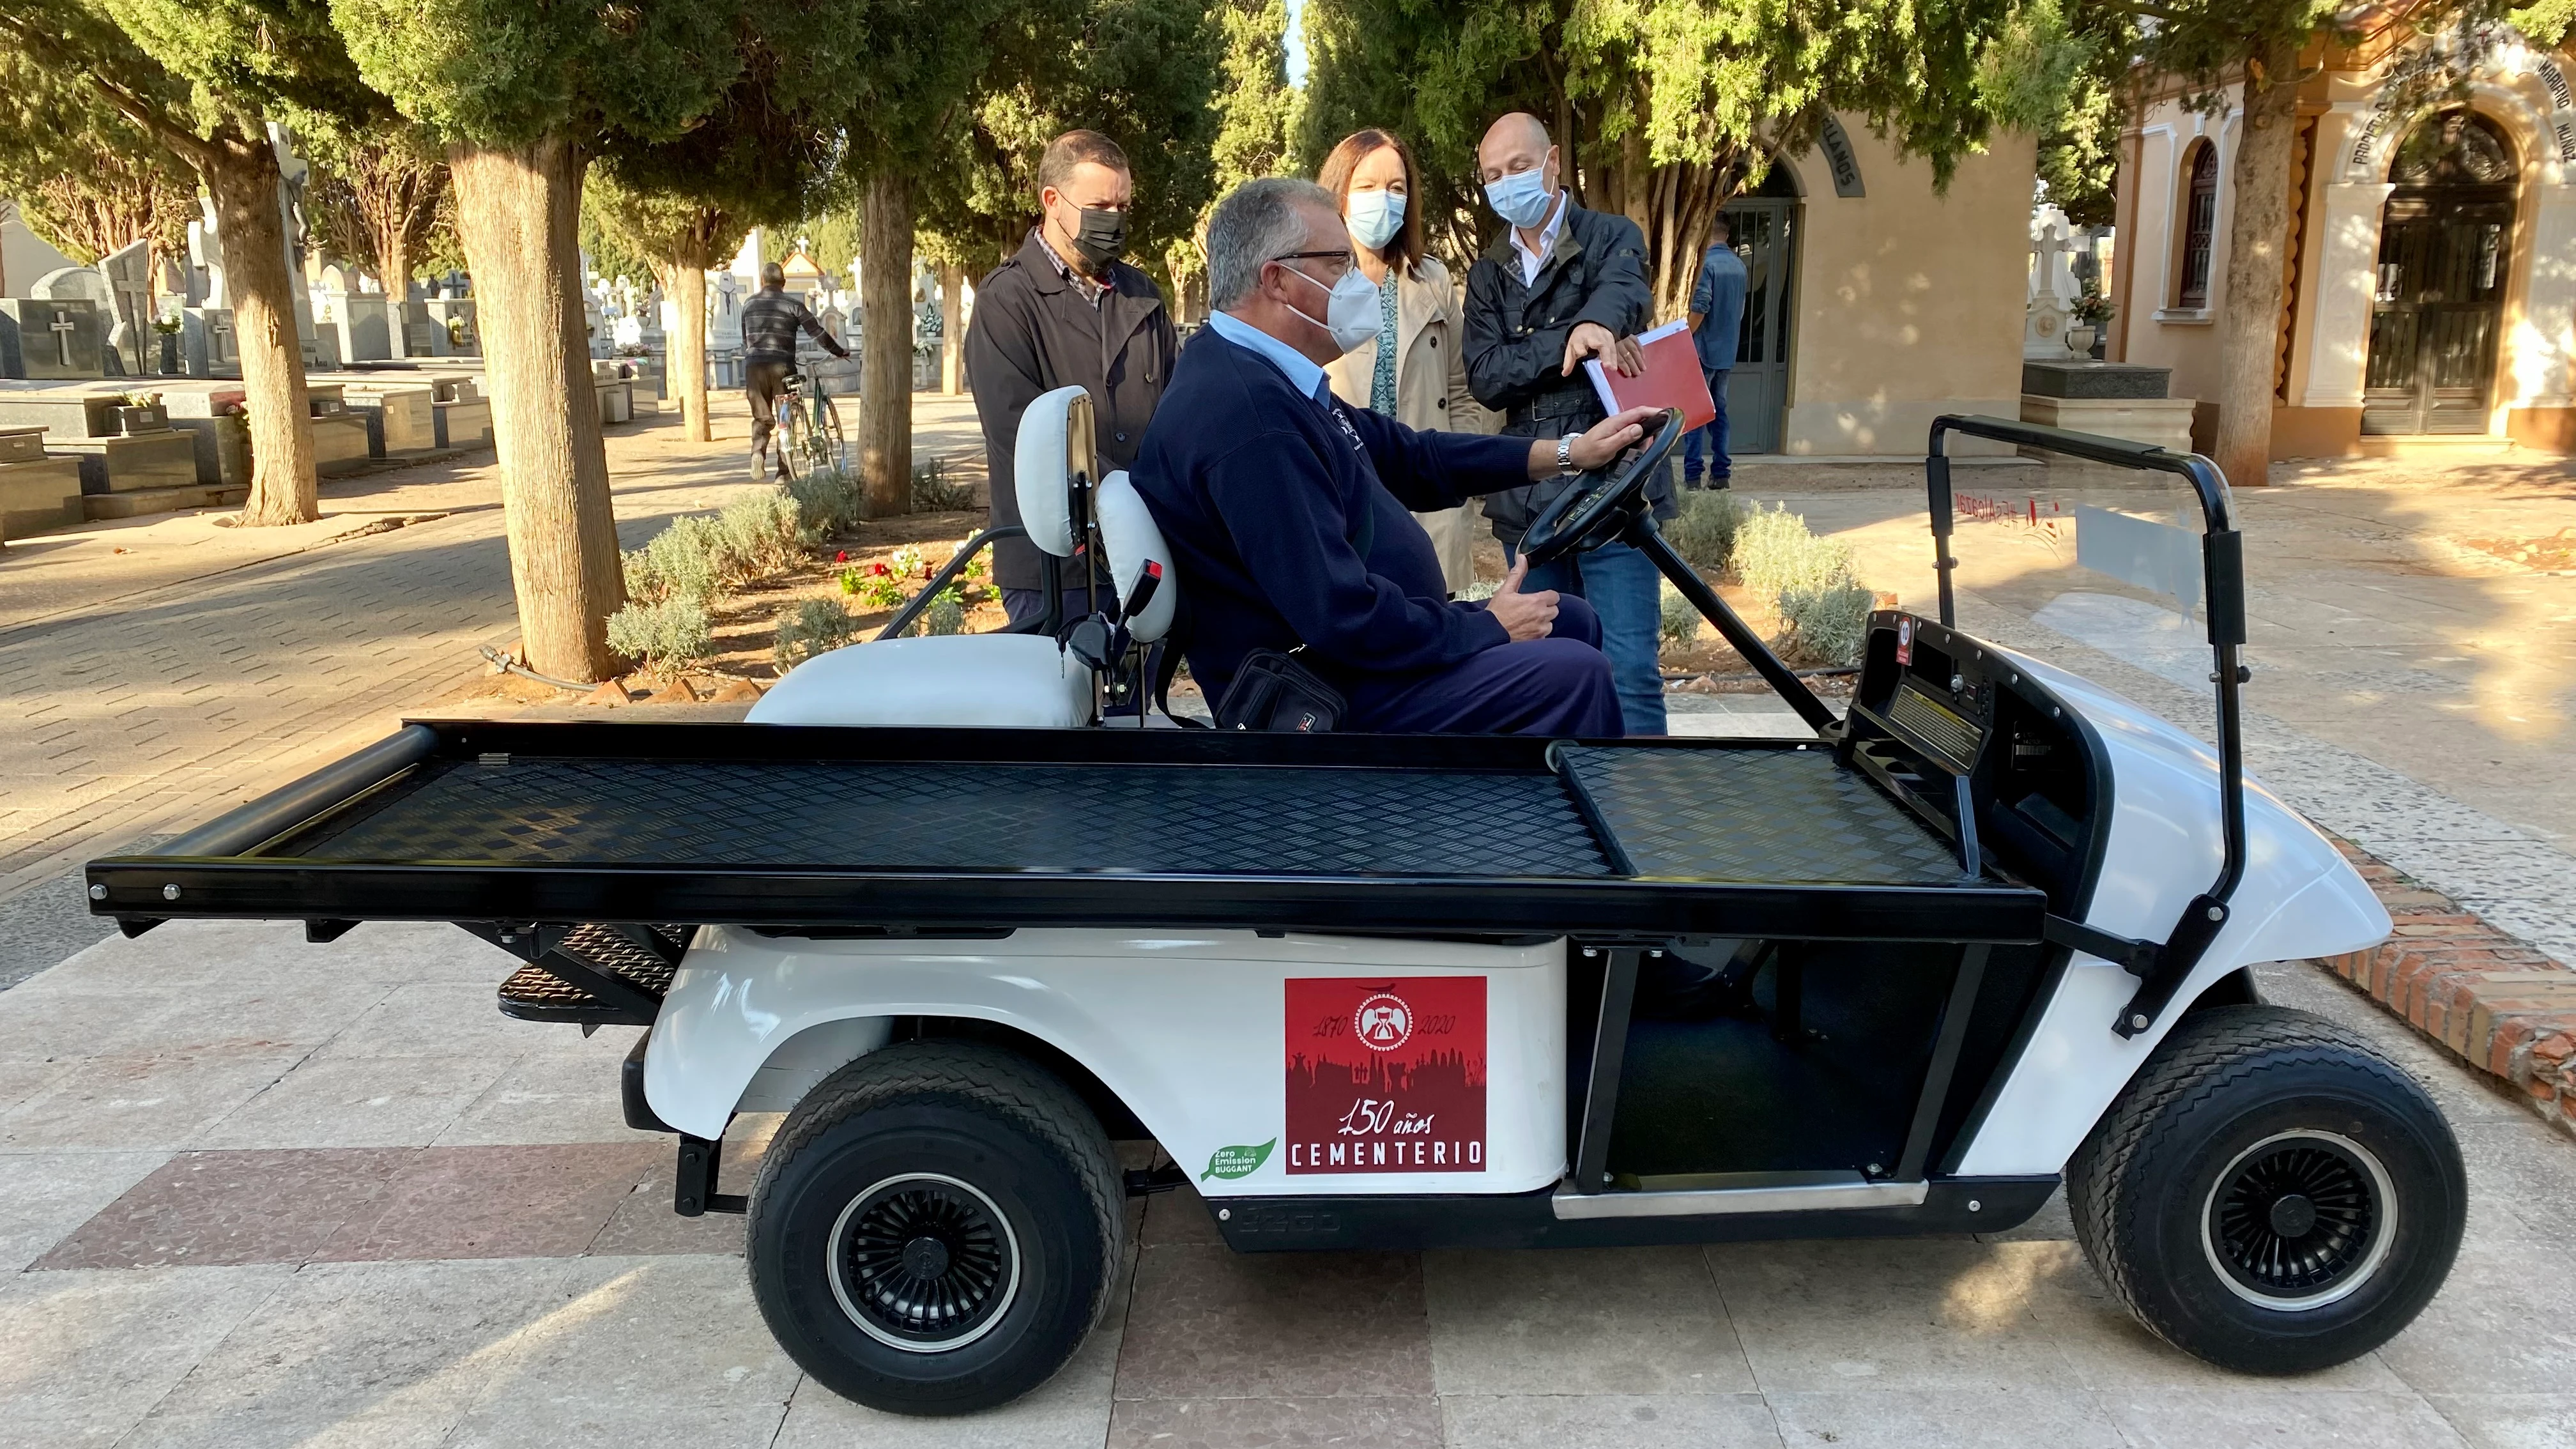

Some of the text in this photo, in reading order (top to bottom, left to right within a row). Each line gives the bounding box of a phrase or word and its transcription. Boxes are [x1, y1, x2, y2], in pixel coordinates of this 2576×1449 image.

[2538, 60, 2570, 109] MARIANO
[1903, 627, 1908, 640] 10
[1312, 1015, 1456, 1038] 1870 2020
[1338, 1098, 1435, 1135] 150 años
[1215, 1156, 1256, 1166] Emission
[1291, 1141, 1481, 1166] CEMENTERIO
[1215, 1165, 1252, 1174] BUGGANT
